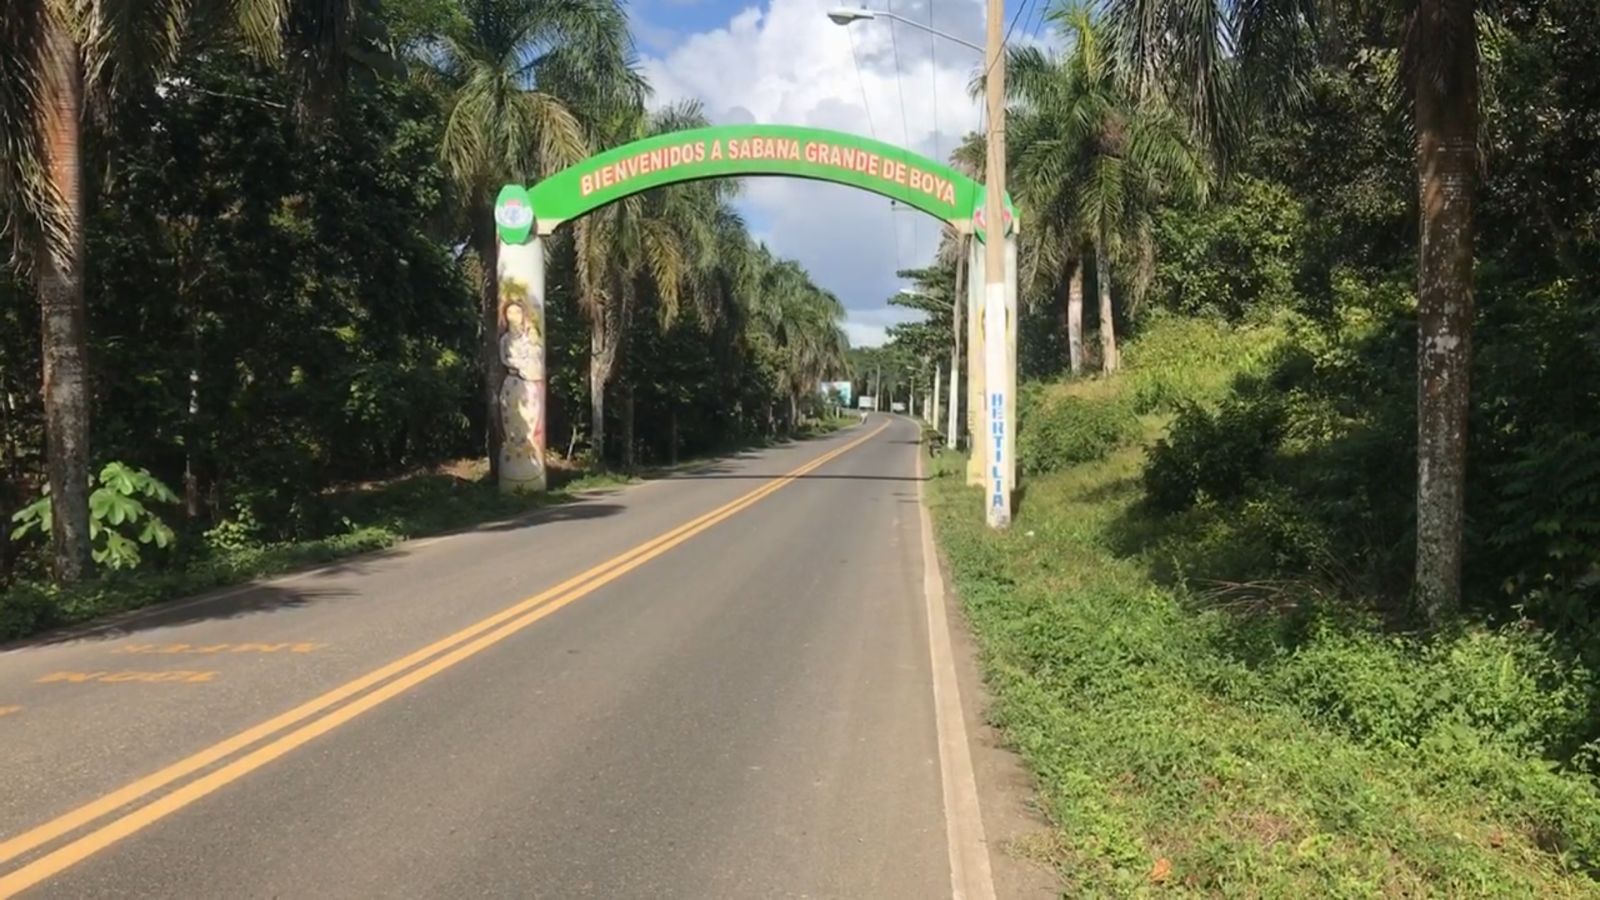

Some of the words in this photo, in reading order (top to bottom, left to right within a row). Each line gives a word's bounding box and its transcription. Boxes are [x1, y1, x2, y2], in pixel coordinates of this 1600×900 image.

[581, 141, 705, 197] BIENVENIDOS
[711, 139, 723, 160] A
[728, 136, 800, 160] SABANA
[804, 142, 880, 176] GRANDE
[882, 157, 907, 184] DE
[909, 167, 957, 207] BOYA
